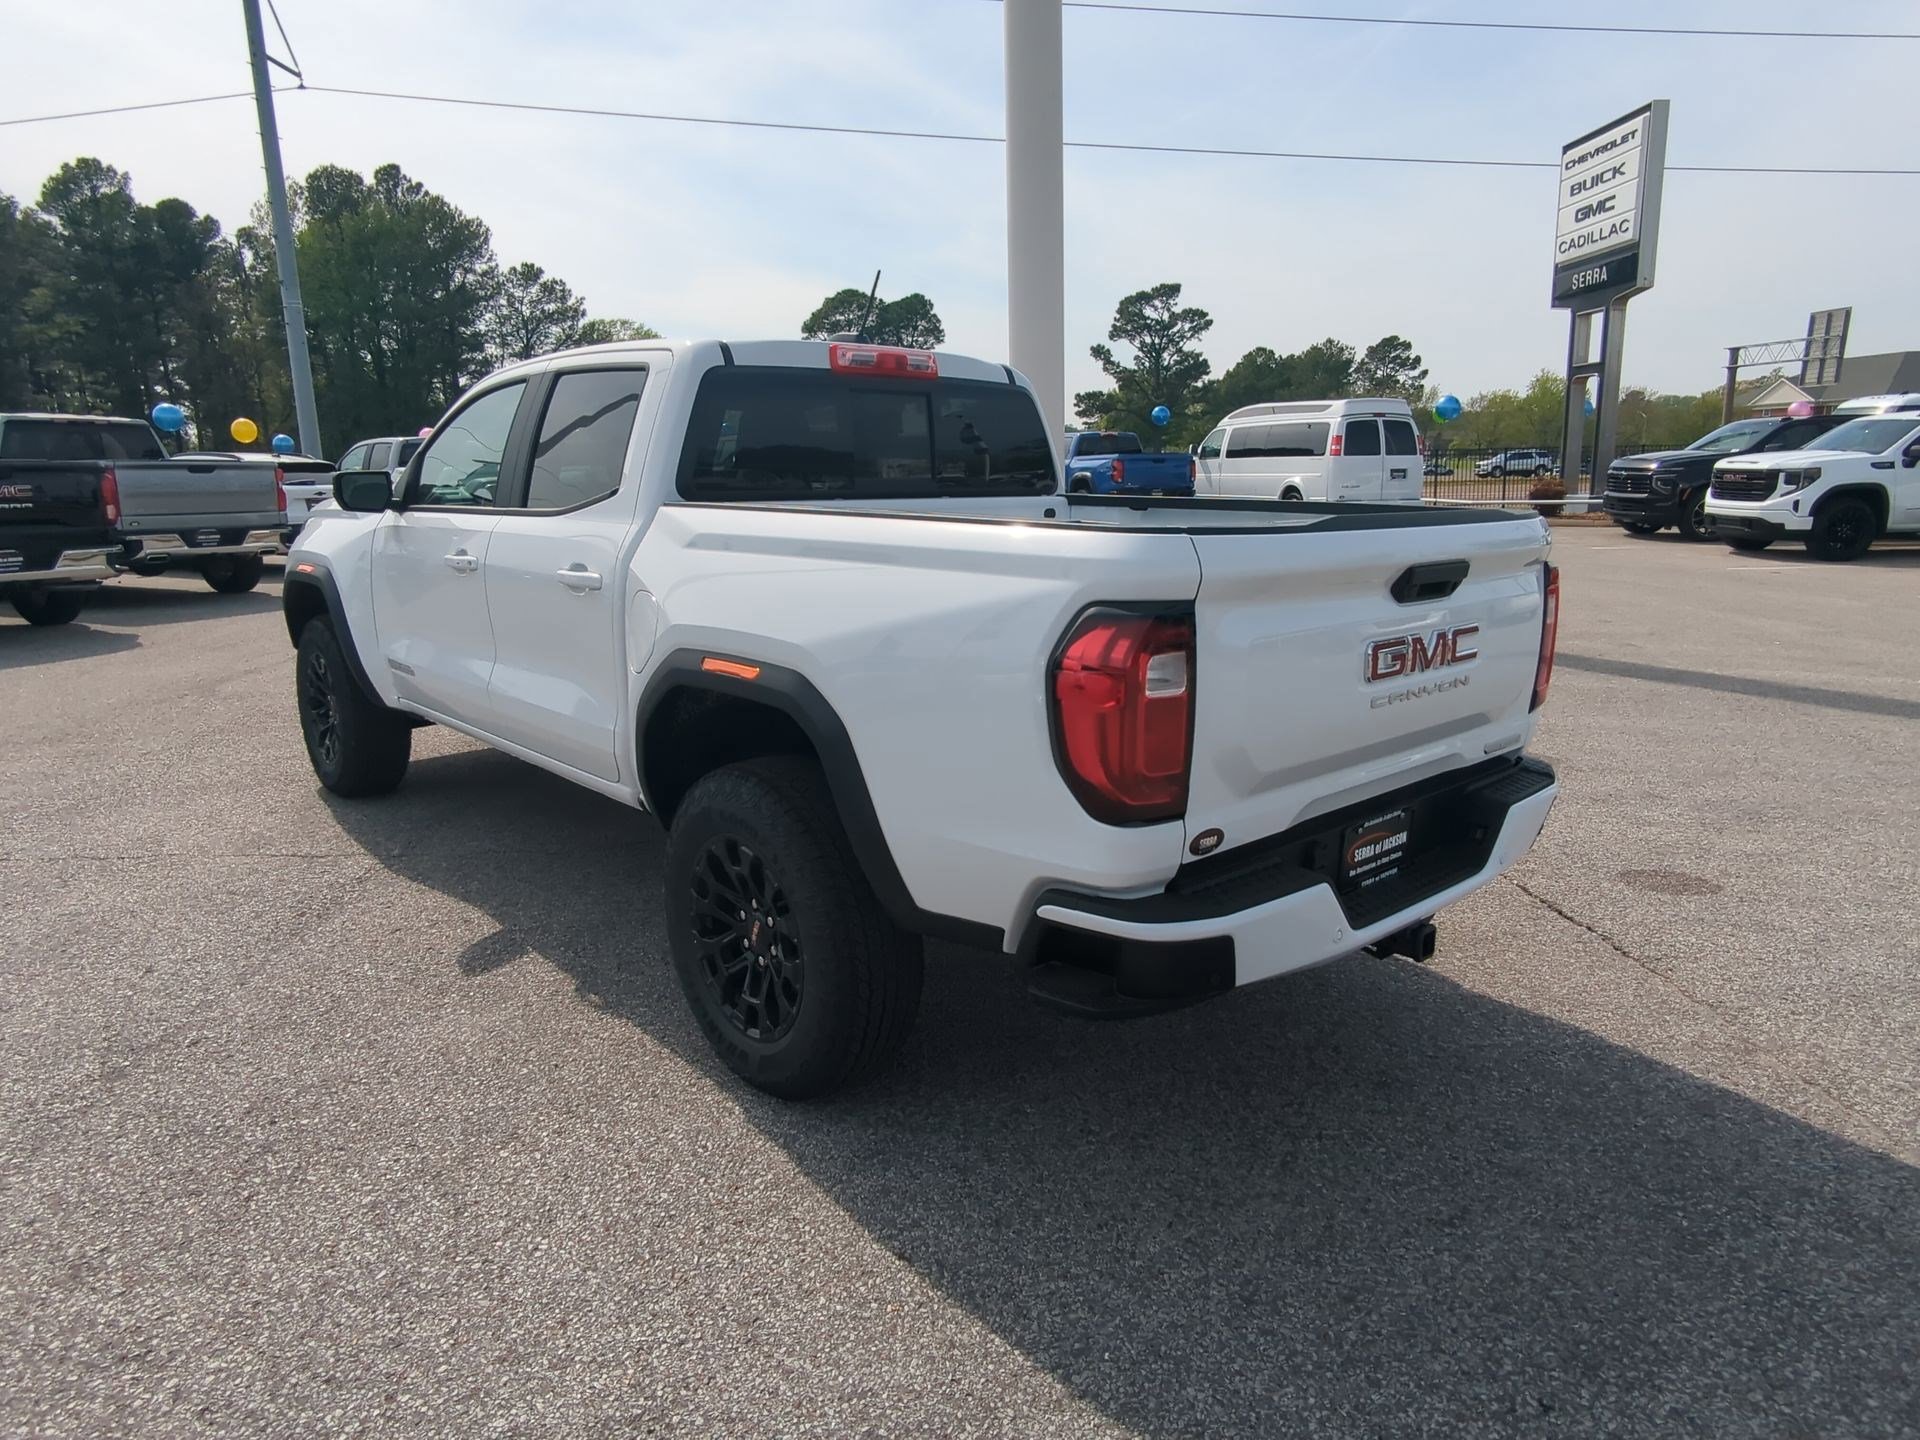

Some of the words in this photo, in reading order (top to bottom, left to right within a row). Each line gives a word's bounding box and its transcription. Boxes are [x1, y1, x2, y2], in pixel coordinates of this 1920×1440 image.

[1564, 129, 1639, 171] CHEVROLET
[1569, 162, 1626, 198] BUICK
[1574, 195, 1616, 224] GMC
[1558, 219, 1630, 254] CADILLAC
[1571, 265, 1608, 290] SERRA
[1364, 622, 1480, 683] GMC
[1370, 675, 1470, 709] CANYON
[1354, 844, 1375, 863] SERRA
[1375, 840, 1383, 855] of
[1382, 831, 1408, 852] JACKSON
